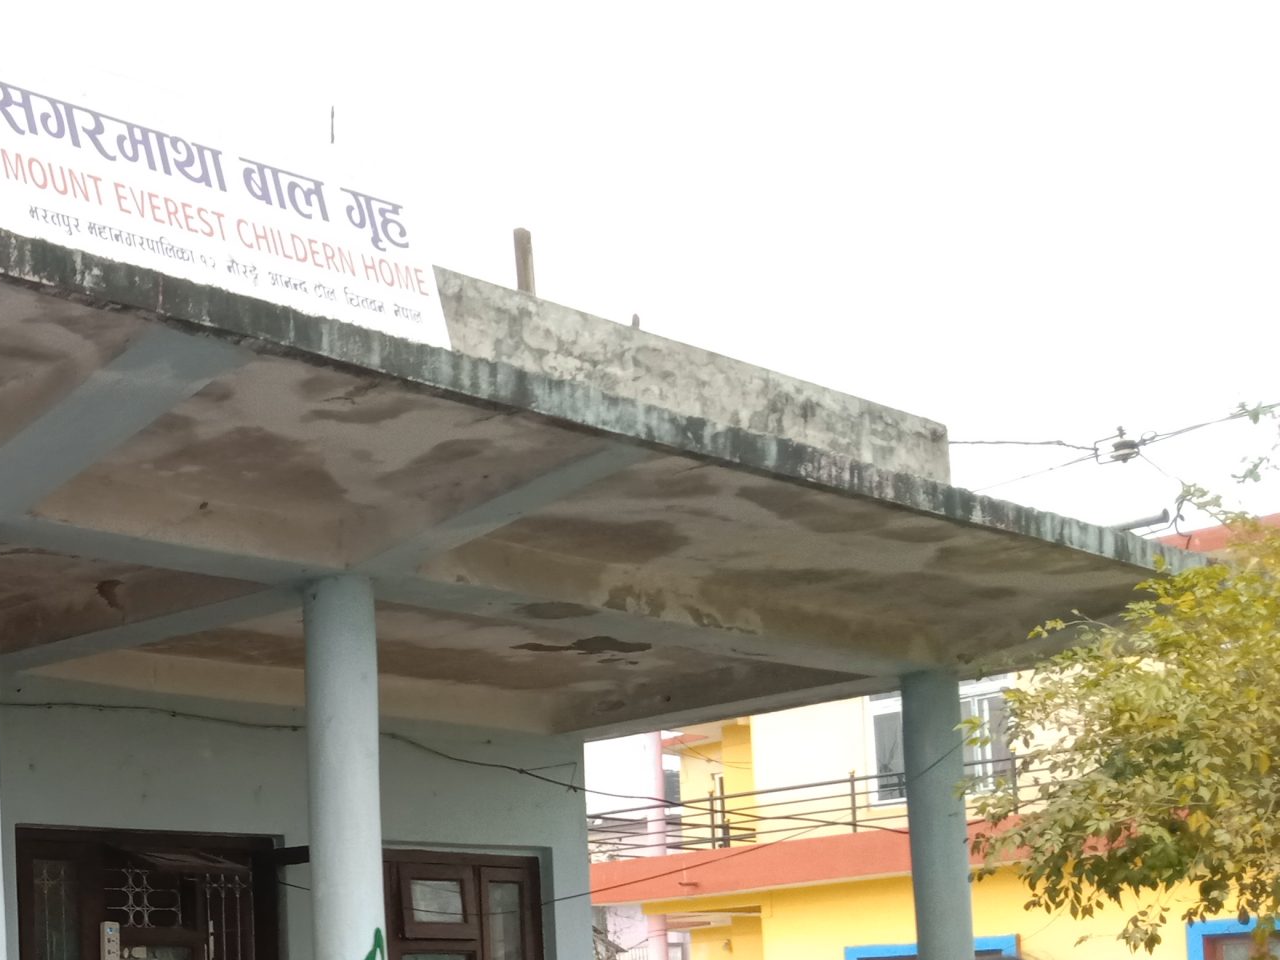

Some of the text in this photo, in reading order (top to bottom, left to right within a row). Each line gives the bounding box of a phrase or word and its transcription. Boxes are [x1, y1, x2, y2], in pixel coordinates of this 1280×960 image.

[0, 148, 102, 206] MOUNT
[113, 182, 225, 241] EVEREST
[236, 218, 356, 277] CHILDERN
[361, 253, 429, 297] HOME
[28, 205, 81, 236] भरतपुर
[87, 221, 195, 264] महानगरपालिका
[239, 157, 329, 222] बाल
[340, 187, 409, 252] गृह
